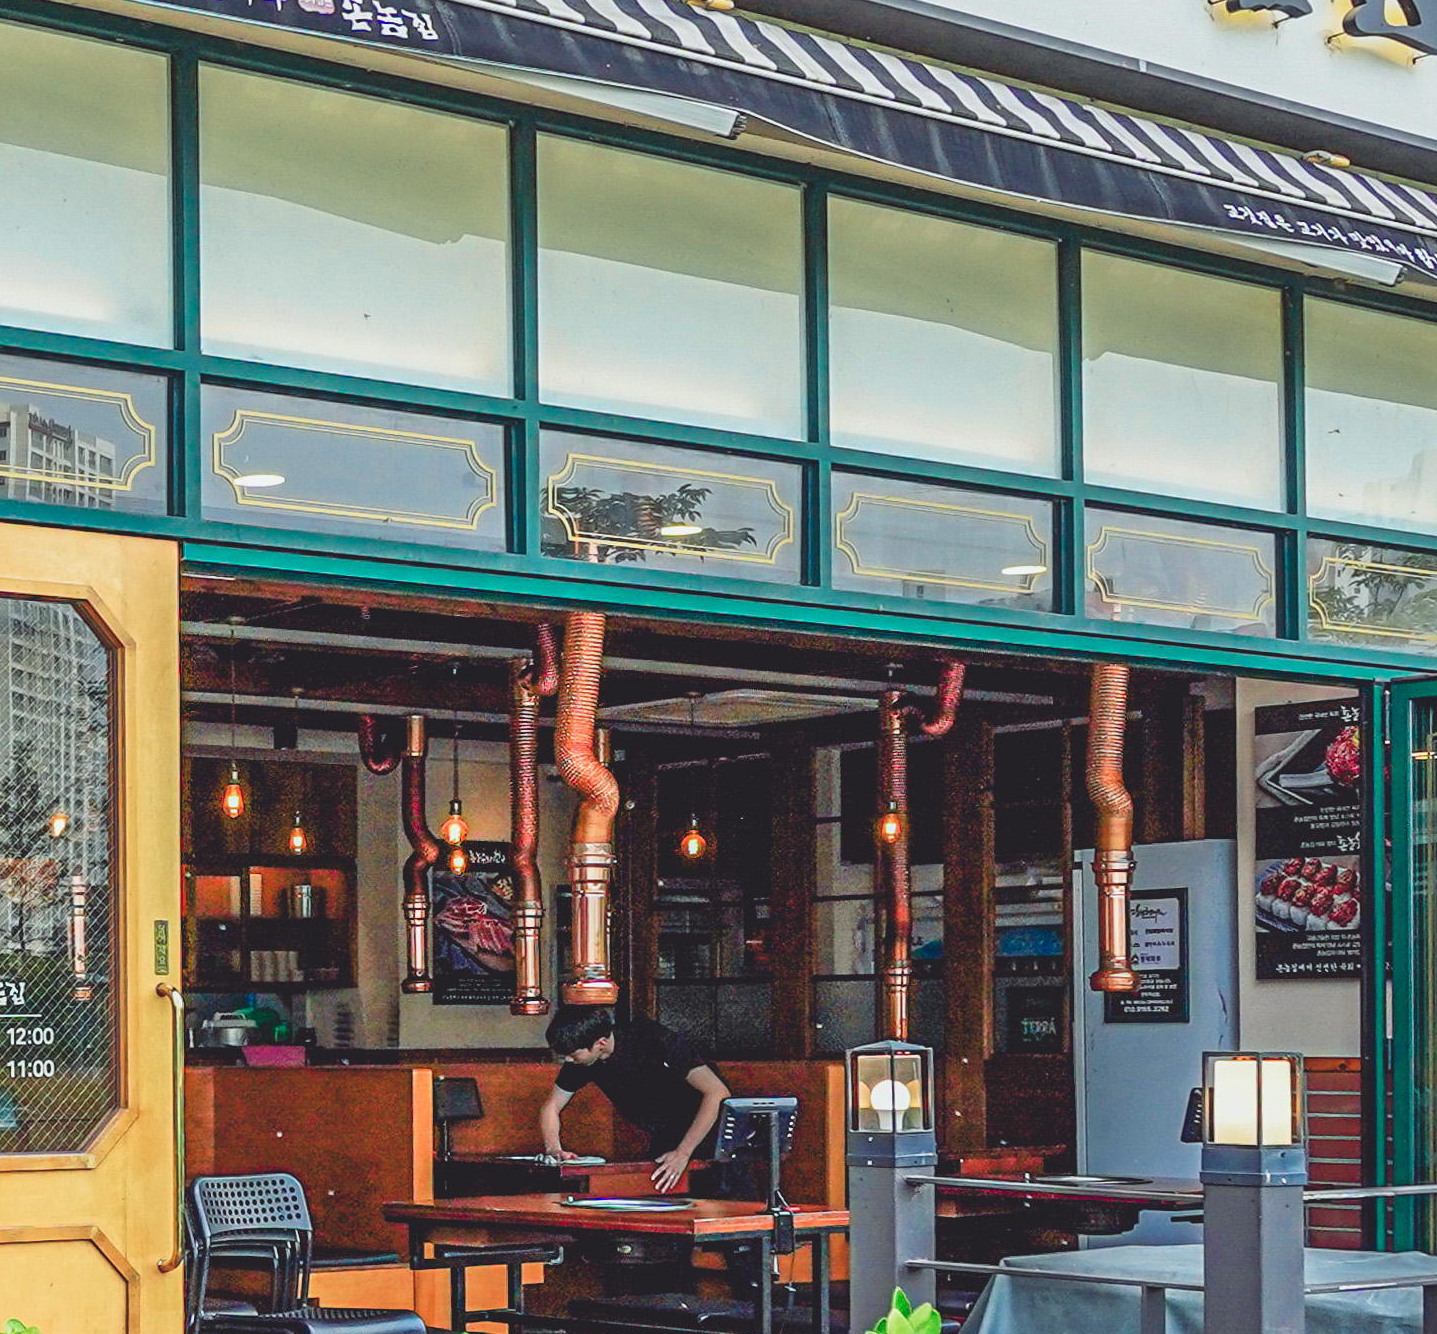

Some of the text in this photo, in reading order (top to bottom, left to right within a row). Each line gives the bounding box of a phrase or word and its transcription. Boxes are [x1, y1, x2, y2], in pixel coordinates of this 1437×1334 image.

[1299, 220, 1349, 246] 고기가
[6, 1027, 55, 1046] 12:00
[6, 1059, 55, 1079] 11:00
